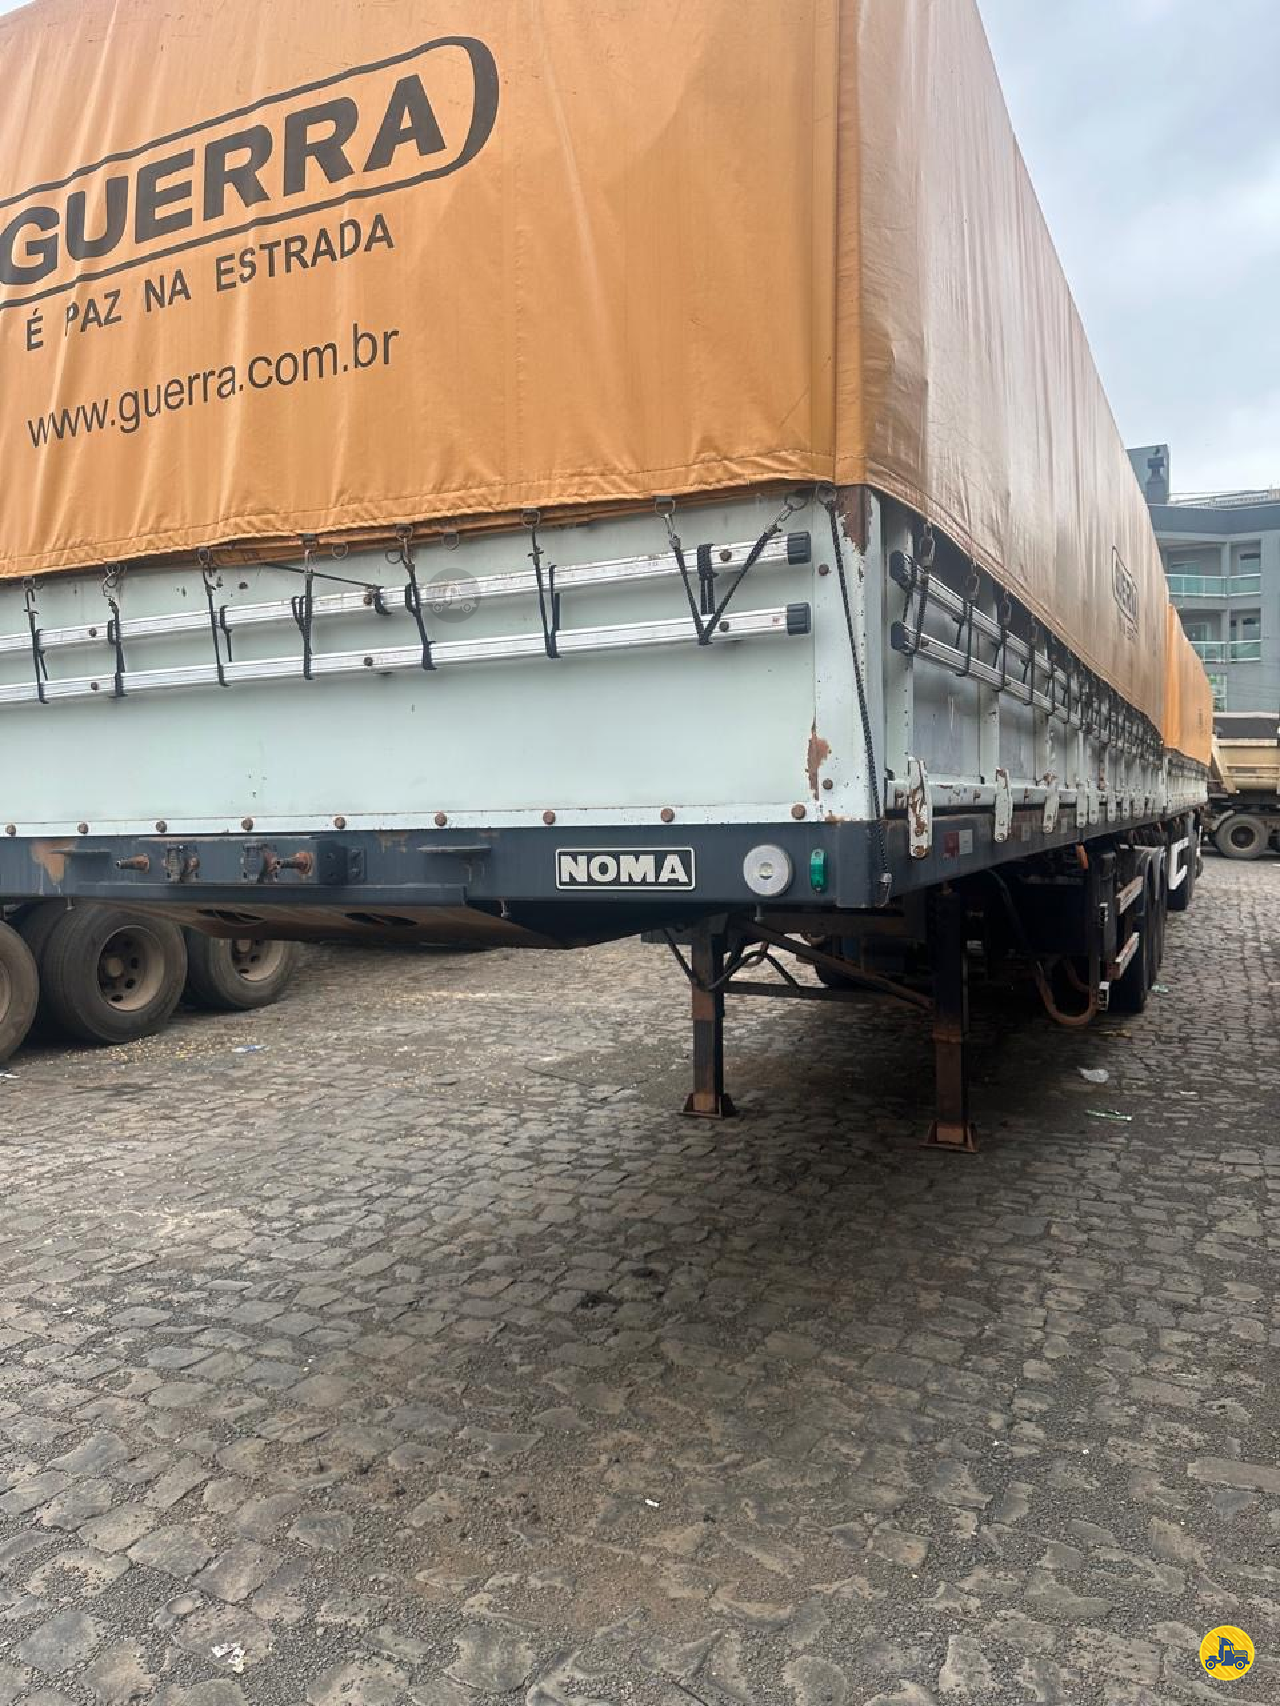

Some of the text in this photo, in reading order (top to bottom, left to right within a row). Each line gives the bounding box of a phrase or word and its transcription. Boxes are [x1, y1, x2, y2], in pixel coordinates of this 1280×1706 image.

[0, 74, 448, 286] GUERRA
[26, 213, 395, 351] É PAZ NA ESTRADA
[27, 323, 399, 447] www.guerra.com.br
[560, 853, 689, 883] NOMA
